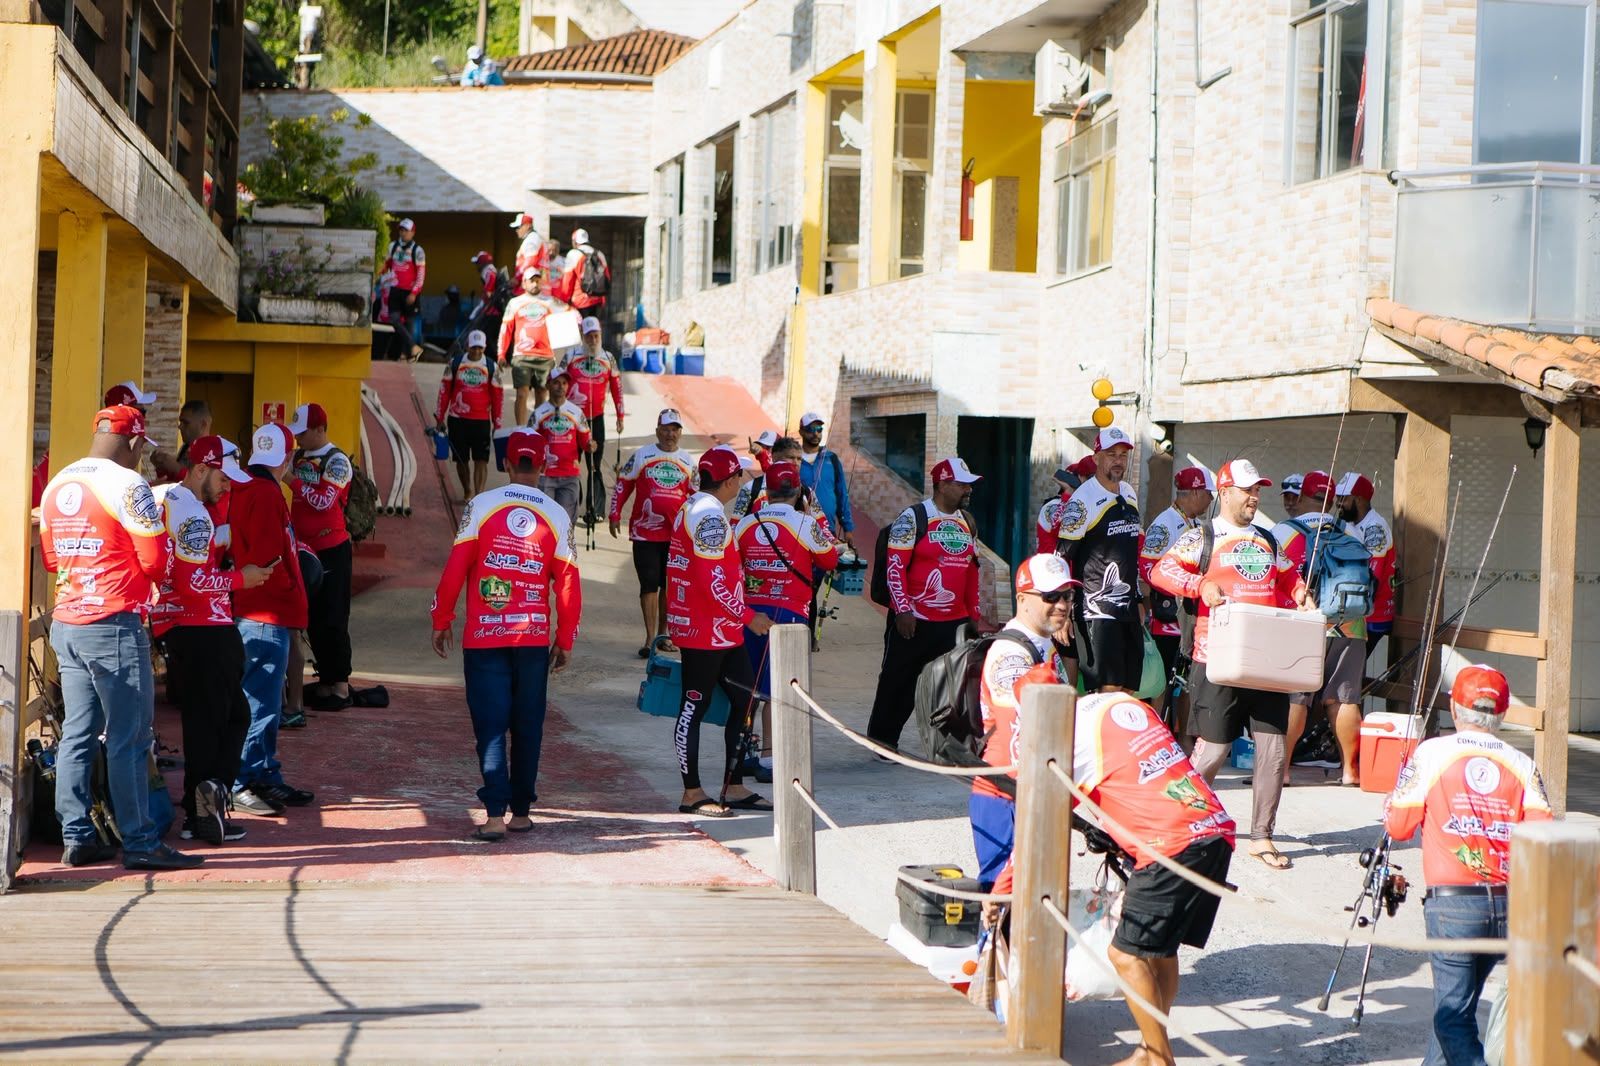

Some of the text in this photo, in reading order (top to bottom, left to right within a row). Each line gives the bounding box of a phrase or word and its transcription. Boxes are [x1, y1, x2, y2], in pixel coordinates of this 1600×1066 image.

[504, 491, 544, 504] COMPETIDOR
[497, 554, 519, 565] HS
[711, 565, 746, 617] Rapos
